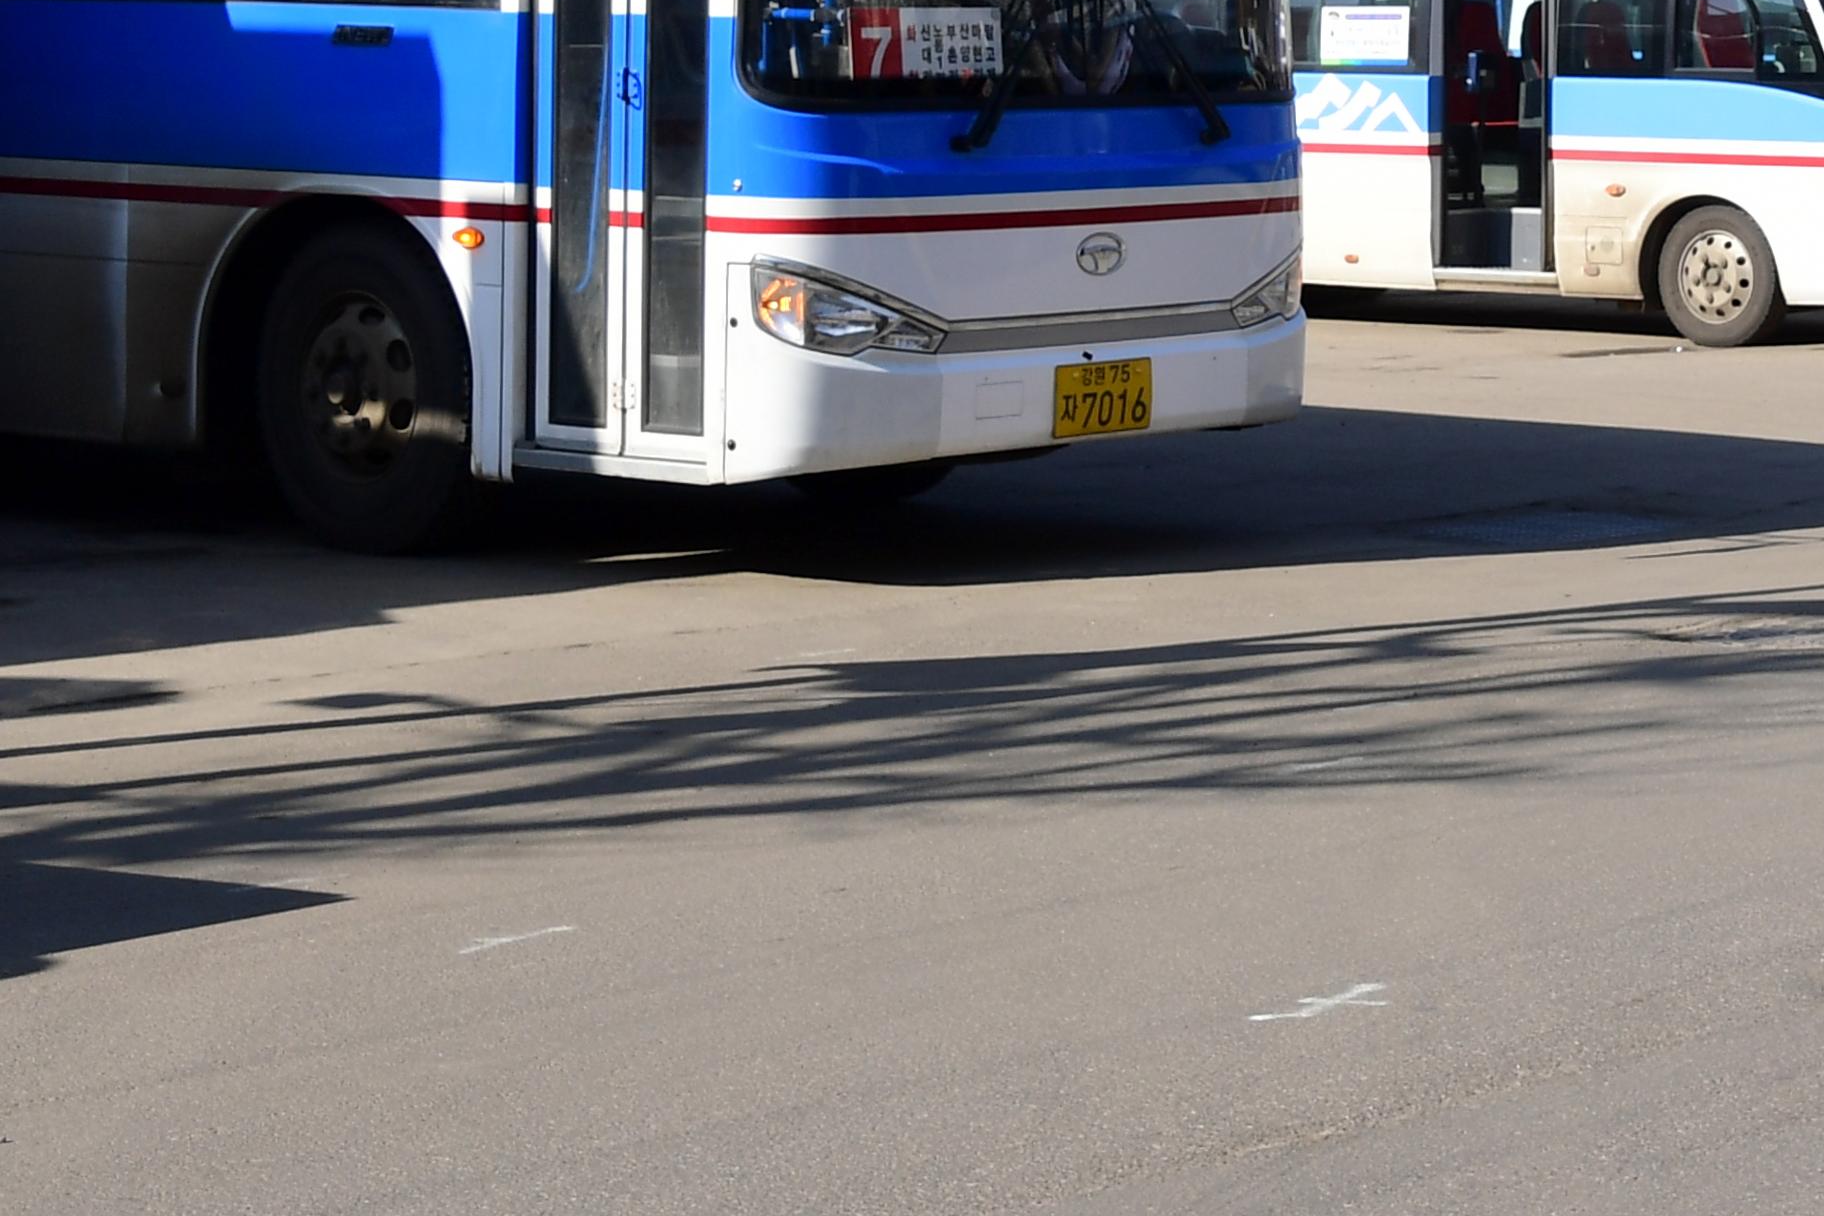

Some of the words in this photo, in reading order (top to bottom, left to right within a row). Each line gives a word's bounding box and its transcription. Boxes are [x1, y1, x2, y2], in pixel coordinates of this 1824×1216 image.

[861, 27, 892, 78] 7
[1082, 366, 1105, 386] 강원
[1110, 363, 1130, 383] 75
[1060, 387, 1147, 429] 자7016
